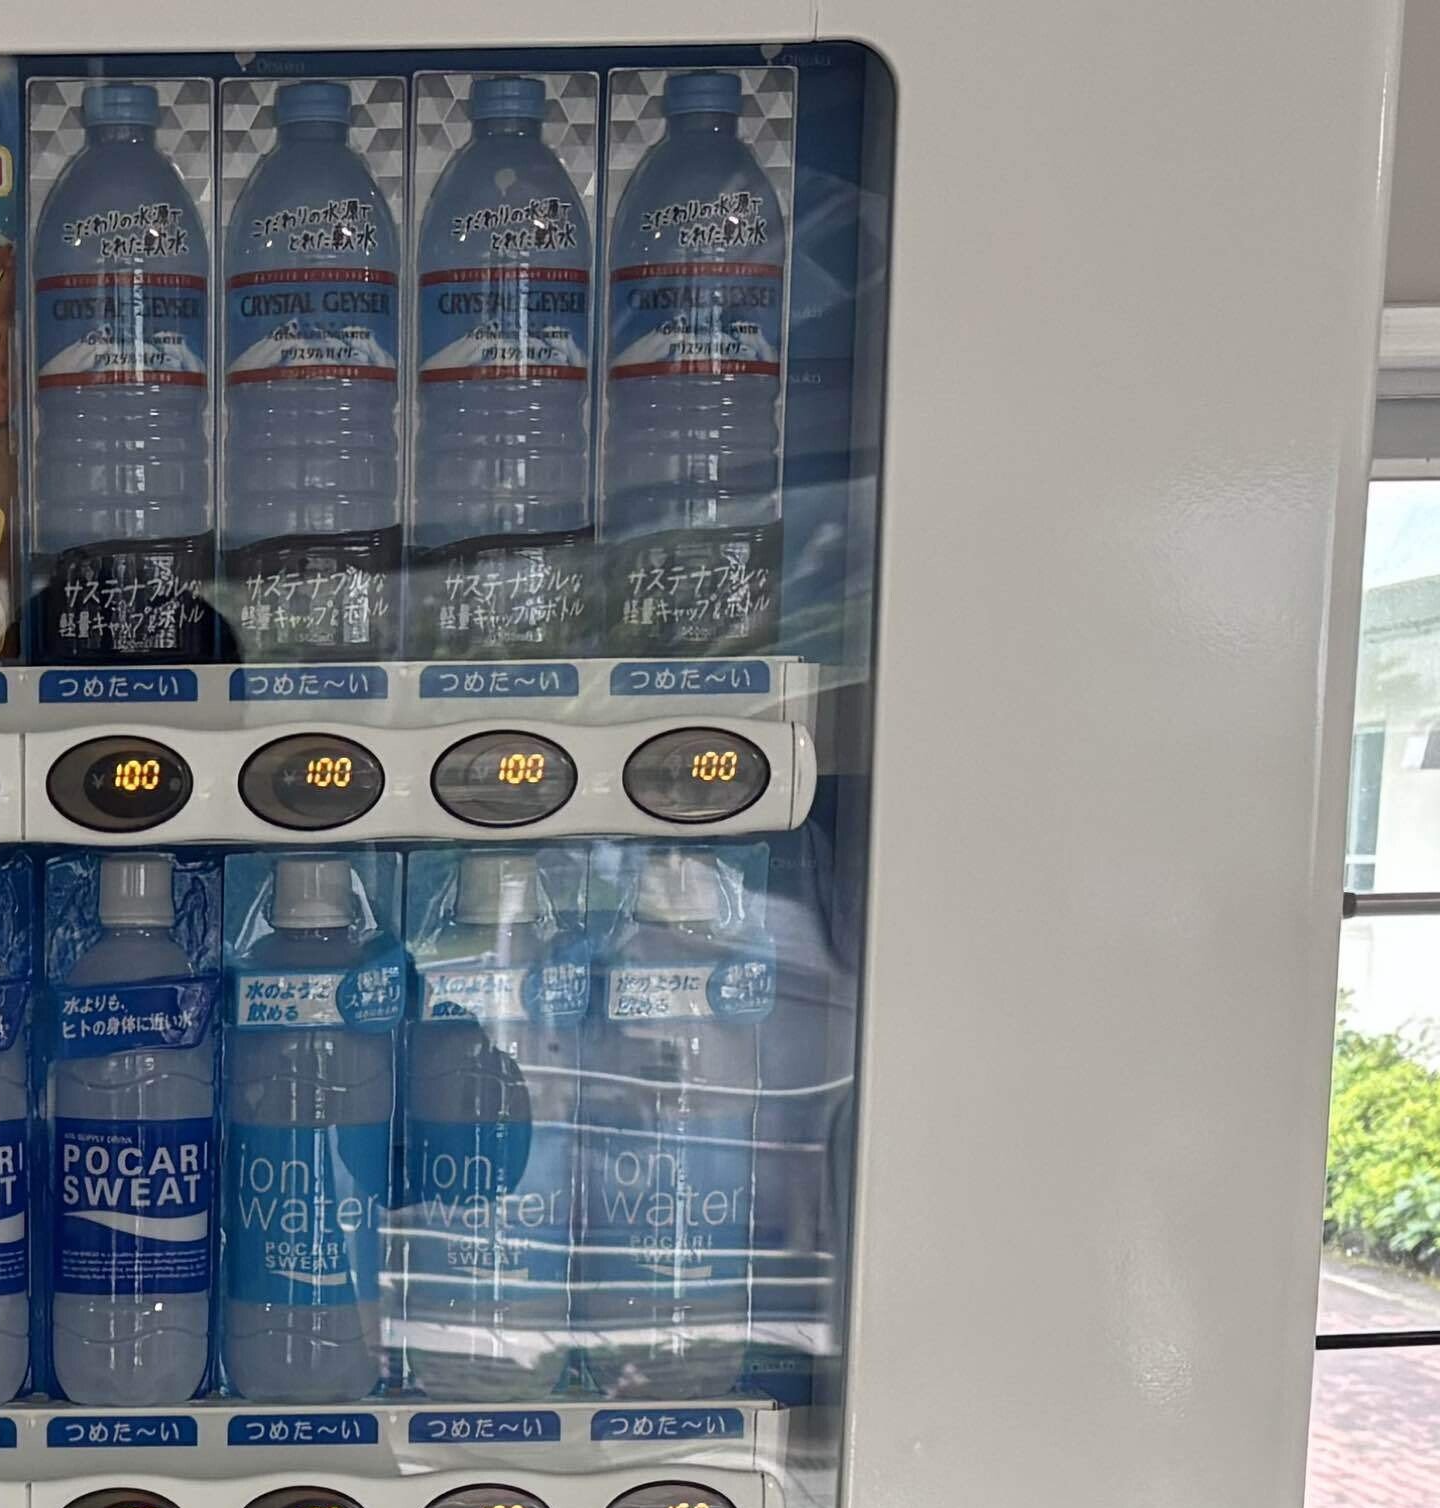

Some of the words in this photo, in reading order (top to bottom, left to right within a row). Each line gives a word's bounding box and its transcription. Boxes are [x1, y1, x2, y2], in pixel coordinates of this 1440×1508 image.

[240, 293, 315, 317] CRYSTAL
[323, 292, 391, 315] GEYSER
[116, 760, 159, 790] 100
[308, 758, 351, 786] 100
[500, 754, 544, 783] 100
[693, 753, 737, 780] 100
[64, 1142, 208, 1177] POCARI
[239, 1142, 310, 1195] ion
[64, 1174, 201, 1208] SWEAT
[238, 1194, 380, 1235] water
